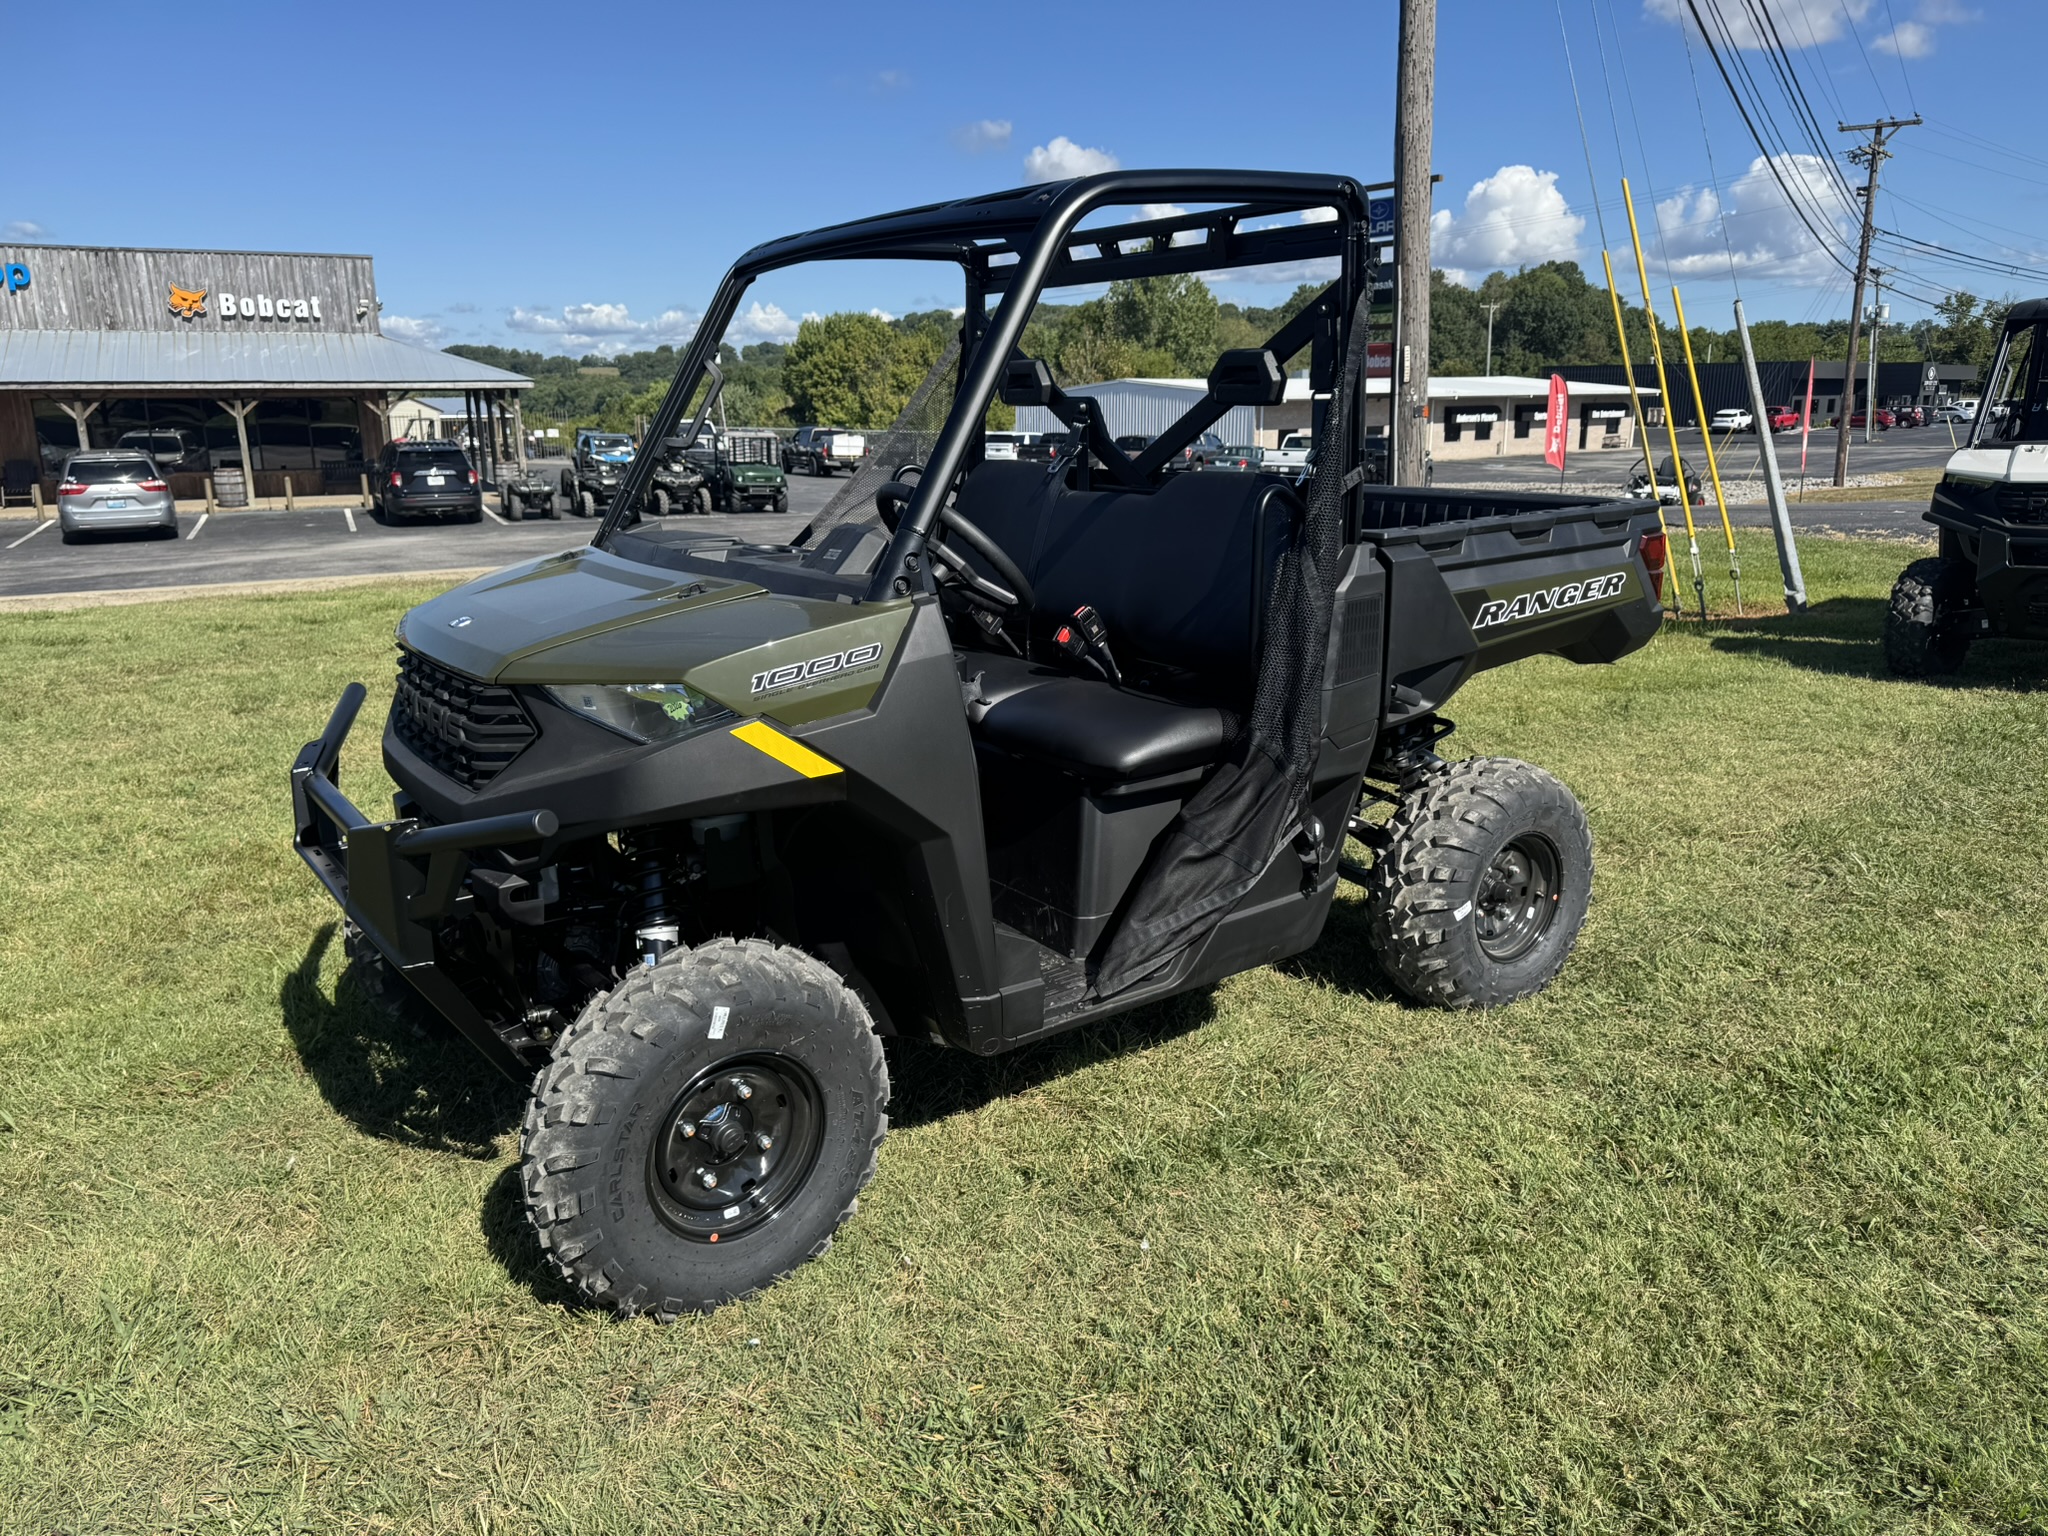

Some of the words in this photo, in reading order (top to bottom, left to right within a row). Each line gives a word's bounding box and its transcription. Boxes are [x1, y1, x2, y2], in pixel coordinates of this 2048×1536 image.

[1370, 220, 1394, 234] LAR
[0, 262, 31, 294] p
[1373, 279, 1394, 291] asak
[218, 292, 322, 319] Bobcat
[1366, 354, 1392, 369] obca
[1471, 571, 1627, 630] RANGER
[750, 641, 884, 694] 1000
[752, 687, 794, 702] SINGLE
[856, 663, 880, 674] CAM
[608, 1101, 645, 1224] CARLSTAR
